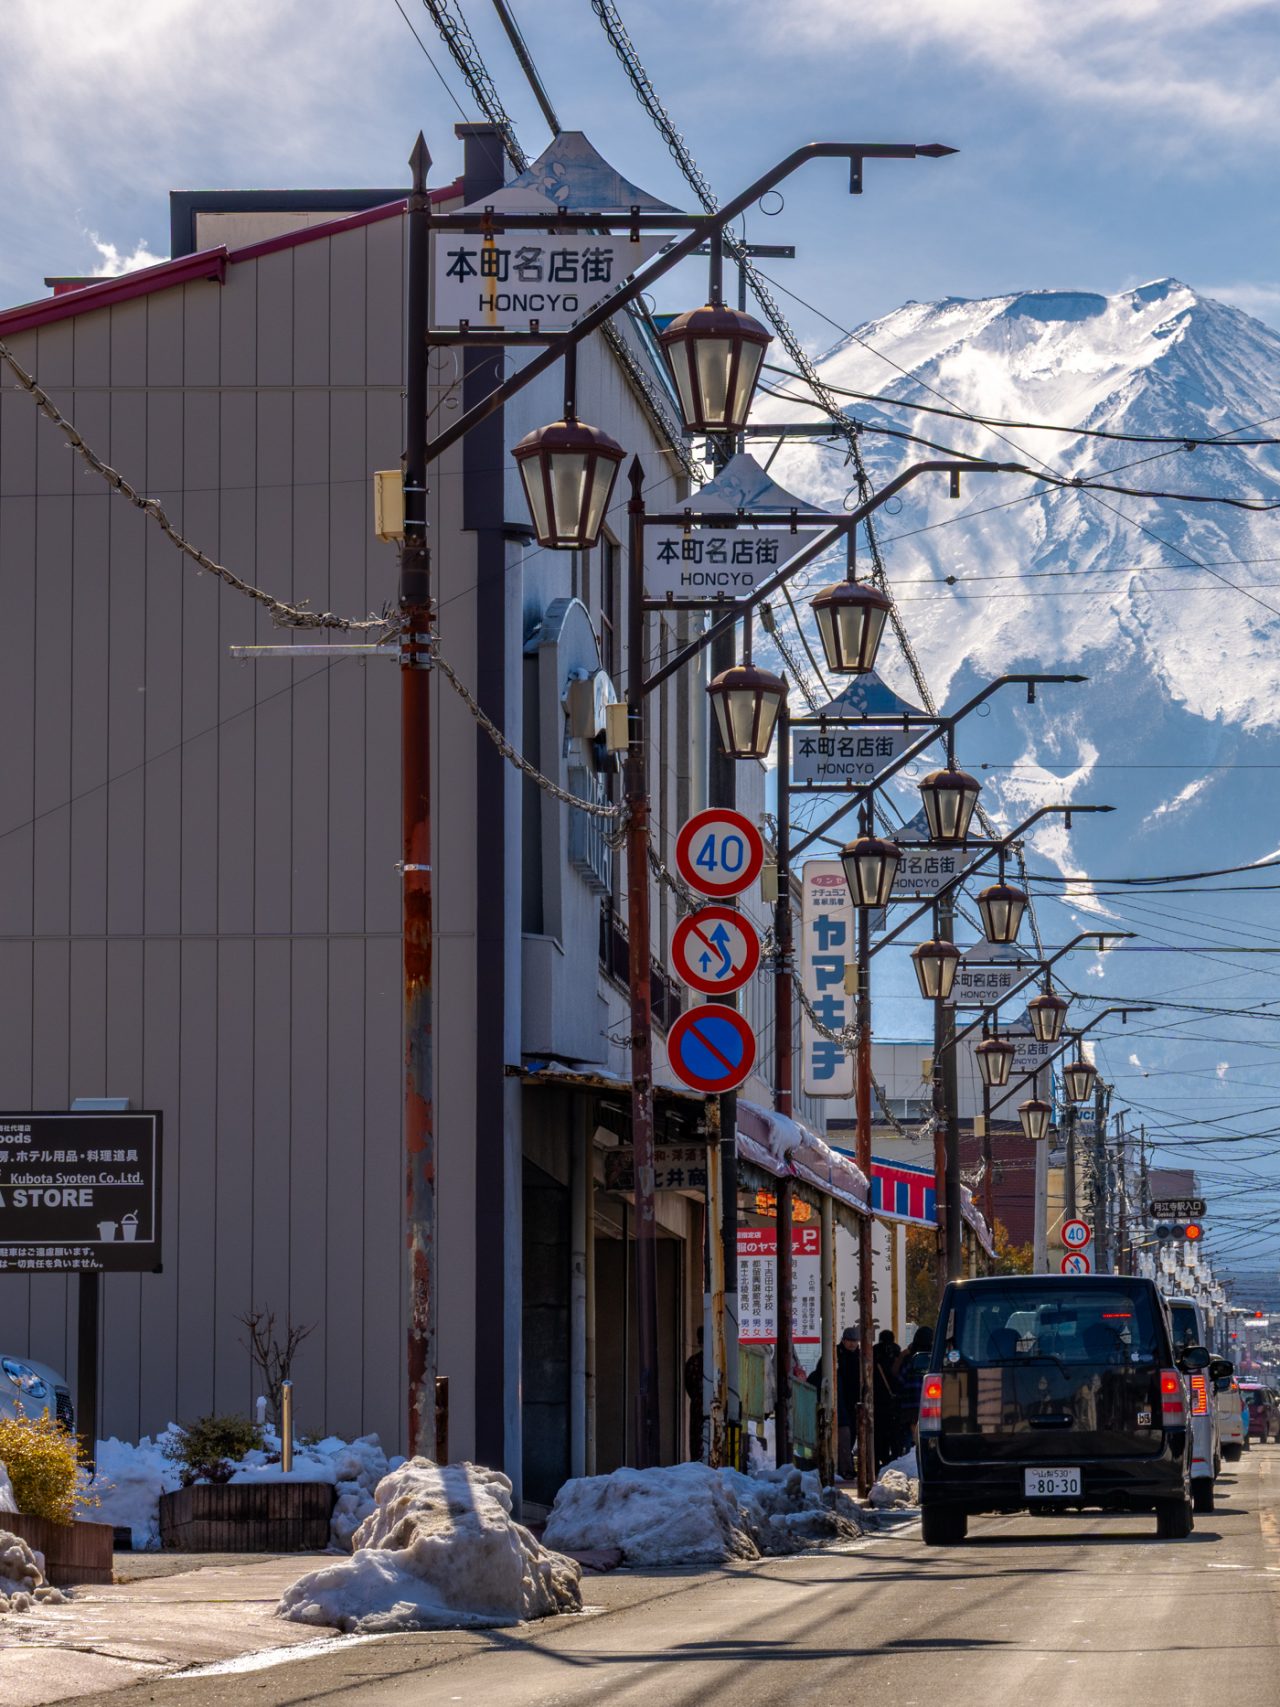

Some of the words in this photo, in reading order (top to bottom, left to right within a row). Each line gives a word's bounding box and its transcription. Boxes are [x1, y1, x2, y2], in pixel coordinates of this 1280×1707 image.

[446, 246, 614, 283] 本町名店街
[656, 537, 779, 565] 本町名店街
[798, 736, 894, 758] 本町名店街
[696, 834, 743, 872] 40
[811, 914, 846, 1081] ヤマキチ
[10, 1173, 53, 1184] Kubota
[56, 1173, 96, 1186] Syoten
[99, 1171, 144, 1185] Co.,Ltd.
[13, 1189, 93, 1208] STORE
[1154, 1201, 1201, 1211] 月江寺駅入口
[803, 1230, 817, 1243] P
[1068, 1227, 1084, 1241] 40
[1038, 1479, 1078, 1493] 80-30
